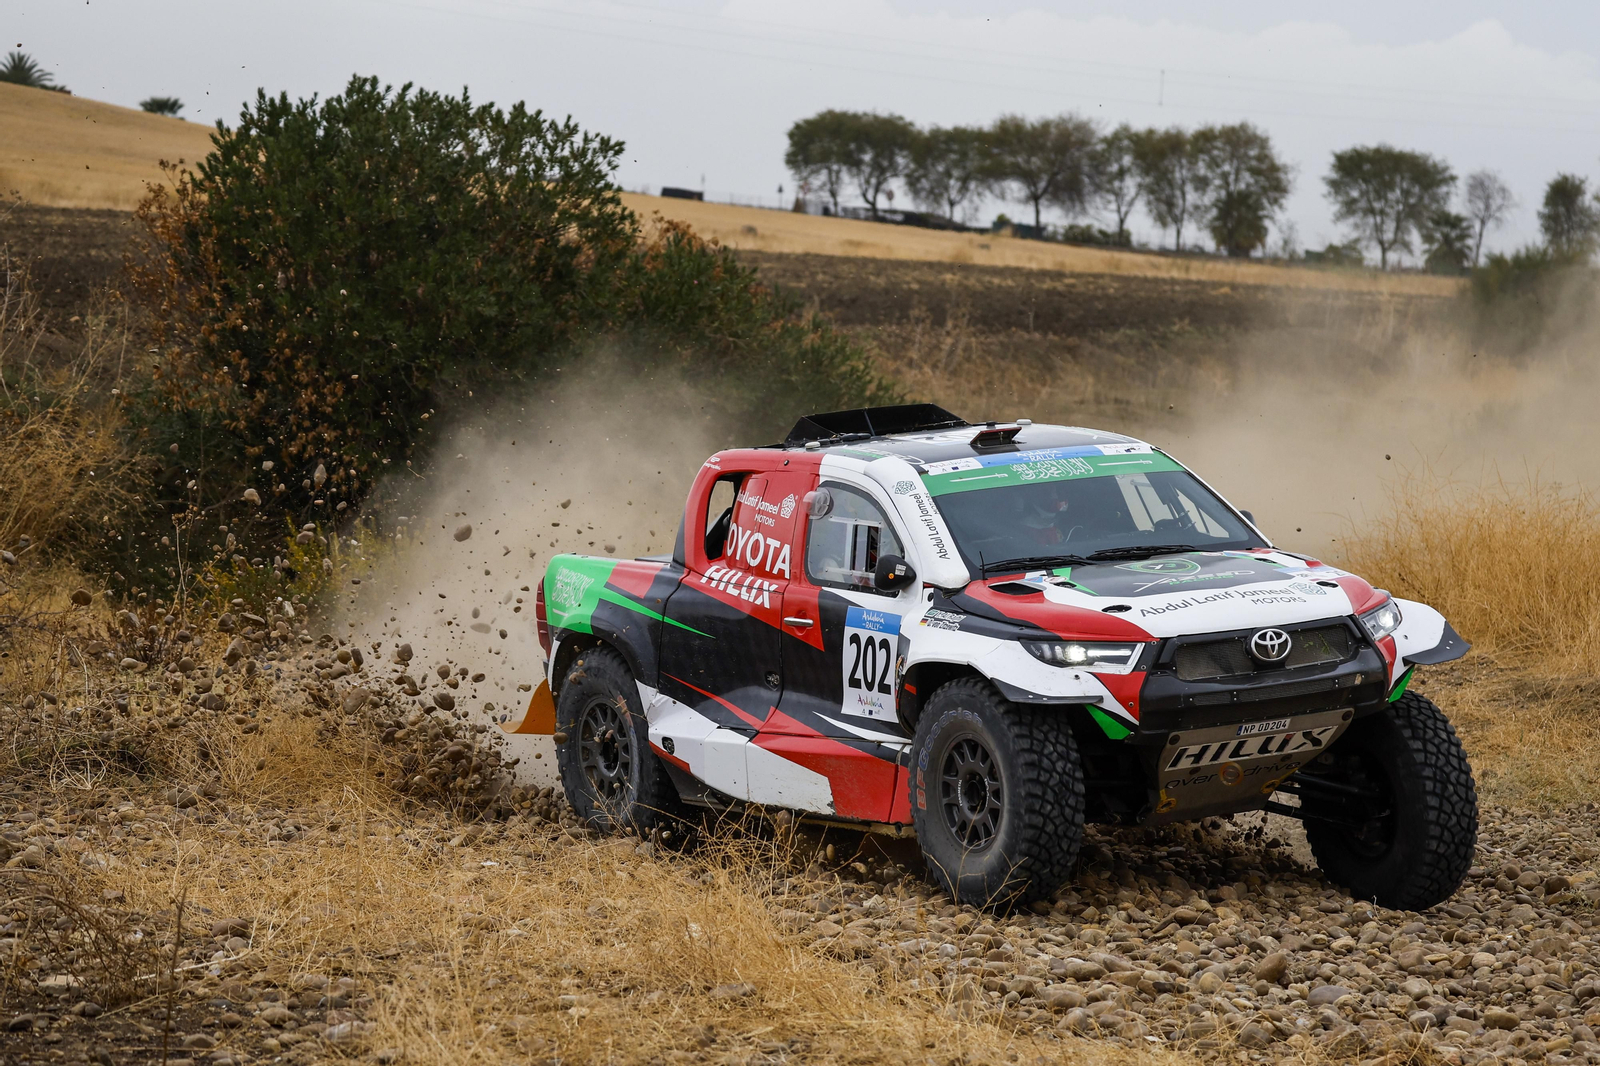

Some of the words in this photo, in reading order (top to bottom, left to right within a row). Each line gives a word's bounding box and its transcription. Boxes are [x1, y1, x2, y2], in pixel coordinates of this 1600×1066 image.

[745, 491, 760, 508] Latif
[756, 496, 781, 514] Jameel
[909, 492, 932, 518] Jameel
[753, 513, 776, 527] MOTORS
[921, 518, 939, 537] Latif
[727, 521, 791, 580] OYOTA
[930, 536, 950, 560] Abdul
[700, 565, 779, 609] HILUX
[1140, 599, 1194, 618] Abdul
[1198, 591, 1236, 606] Latif
[1236, 586, 1296, 599] Jameel
[1251, 596, 1307, 606] MOTORS
[865, 621, 881, 631] RALLY
[848, 632, 892, 696] 202
[1242, 724, 1256, 735] NP
[1168, 726, 1333, 769] HILUX
[1164, 772, 1219, 789] over
[1243, 761, 1301, 777] drive
